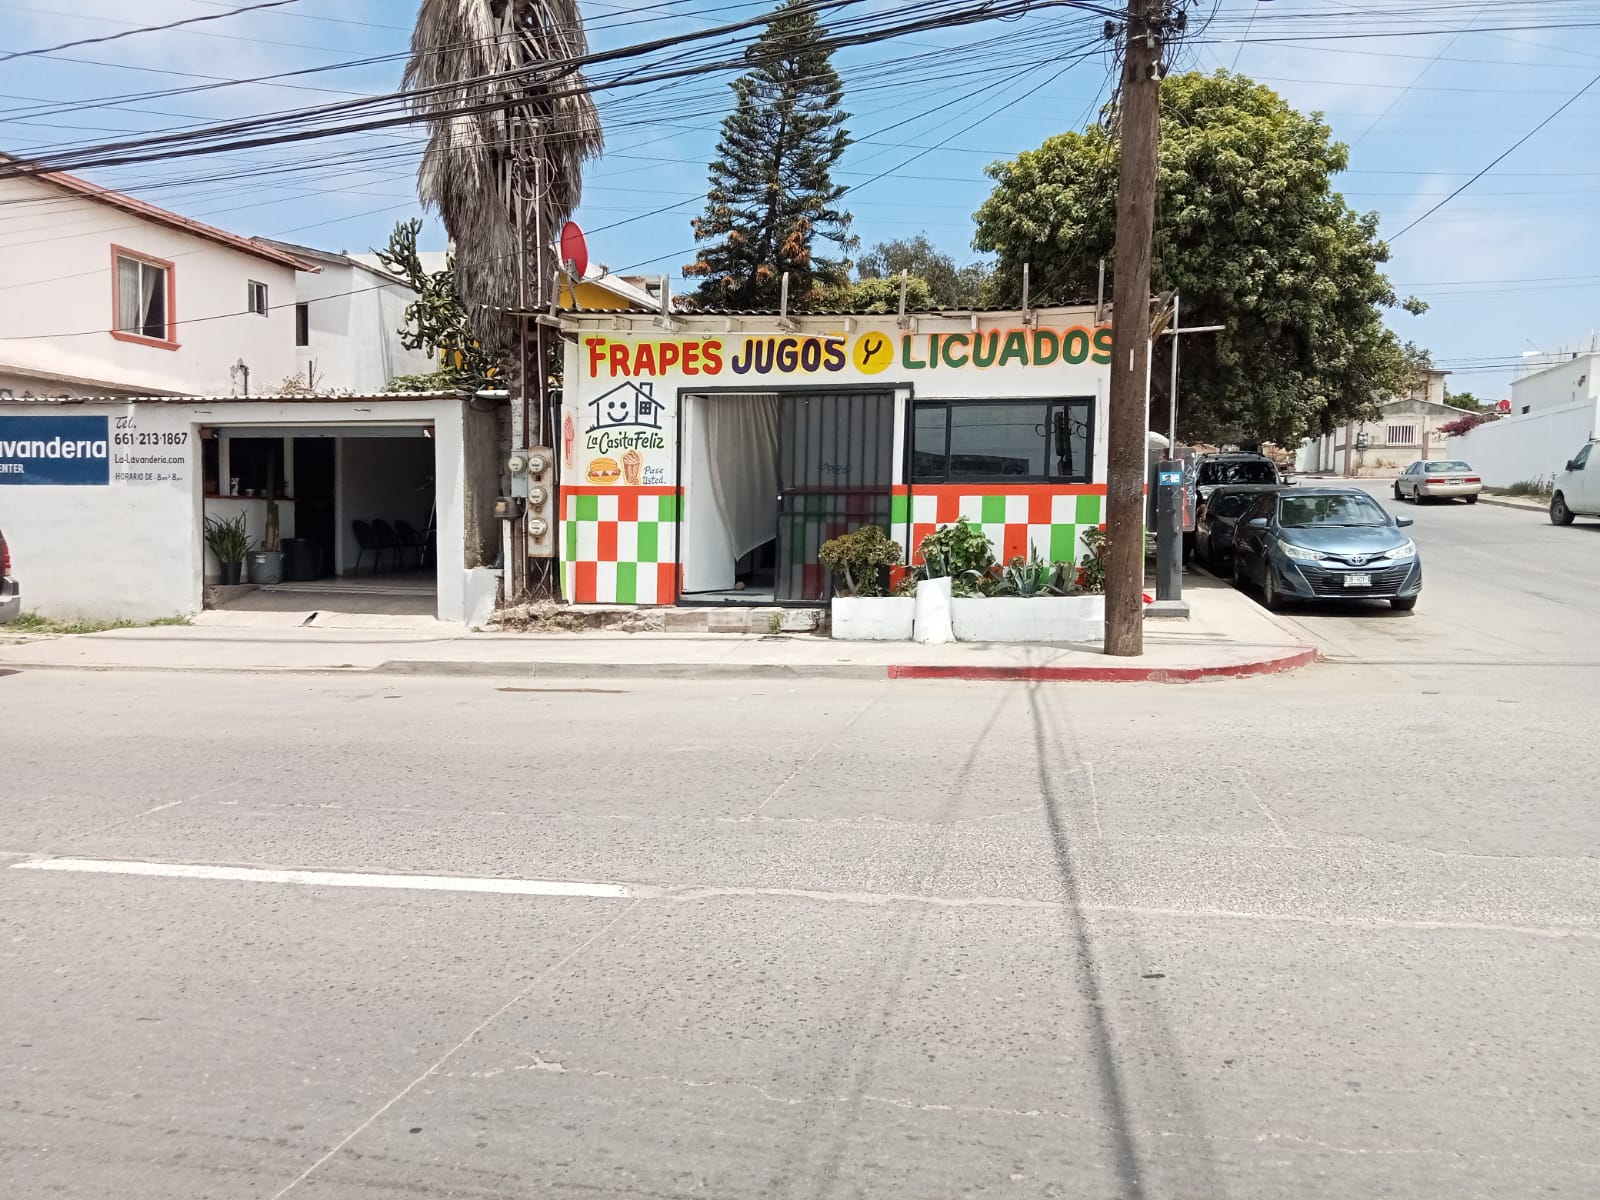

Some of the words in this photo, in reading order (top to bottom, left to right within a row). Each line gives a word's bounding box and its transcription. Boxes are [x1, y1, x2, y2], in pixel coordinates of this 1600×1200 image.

[585, 338, 723, 378] FRAPES
[731, 337, 847, 375] JUGOS
[902, 328, 1114, 370] LICUADOS
[586, 434, 599, 450] La
[598, 431, 633, 455] Casita
[634, 431, 665, 450] Feliz
